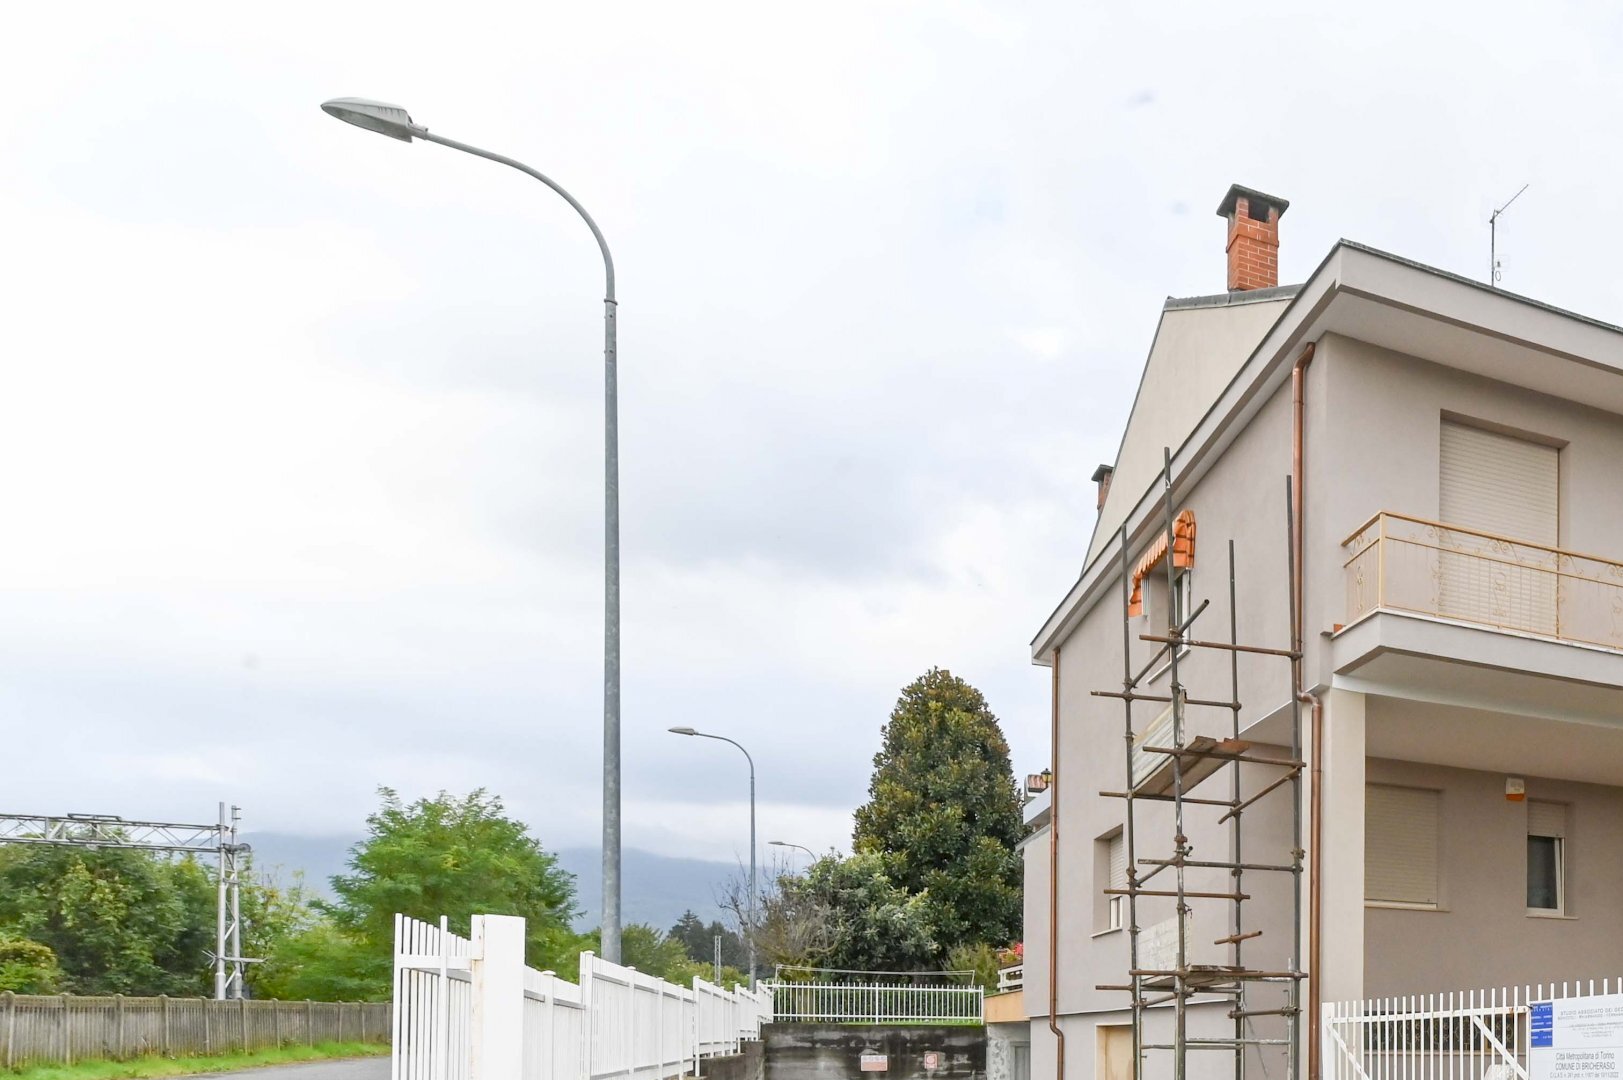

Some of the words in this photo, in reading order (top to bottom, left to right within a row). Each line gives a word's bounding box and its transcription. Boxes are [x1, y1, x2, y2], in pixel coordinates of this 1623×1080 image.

[1566, 1052, 1594, 1061] Metropolitana
[1555, 1062, 1575, 1070] COMUNE
[1581, 1062, 1615, 1070] BRICHERASIO
